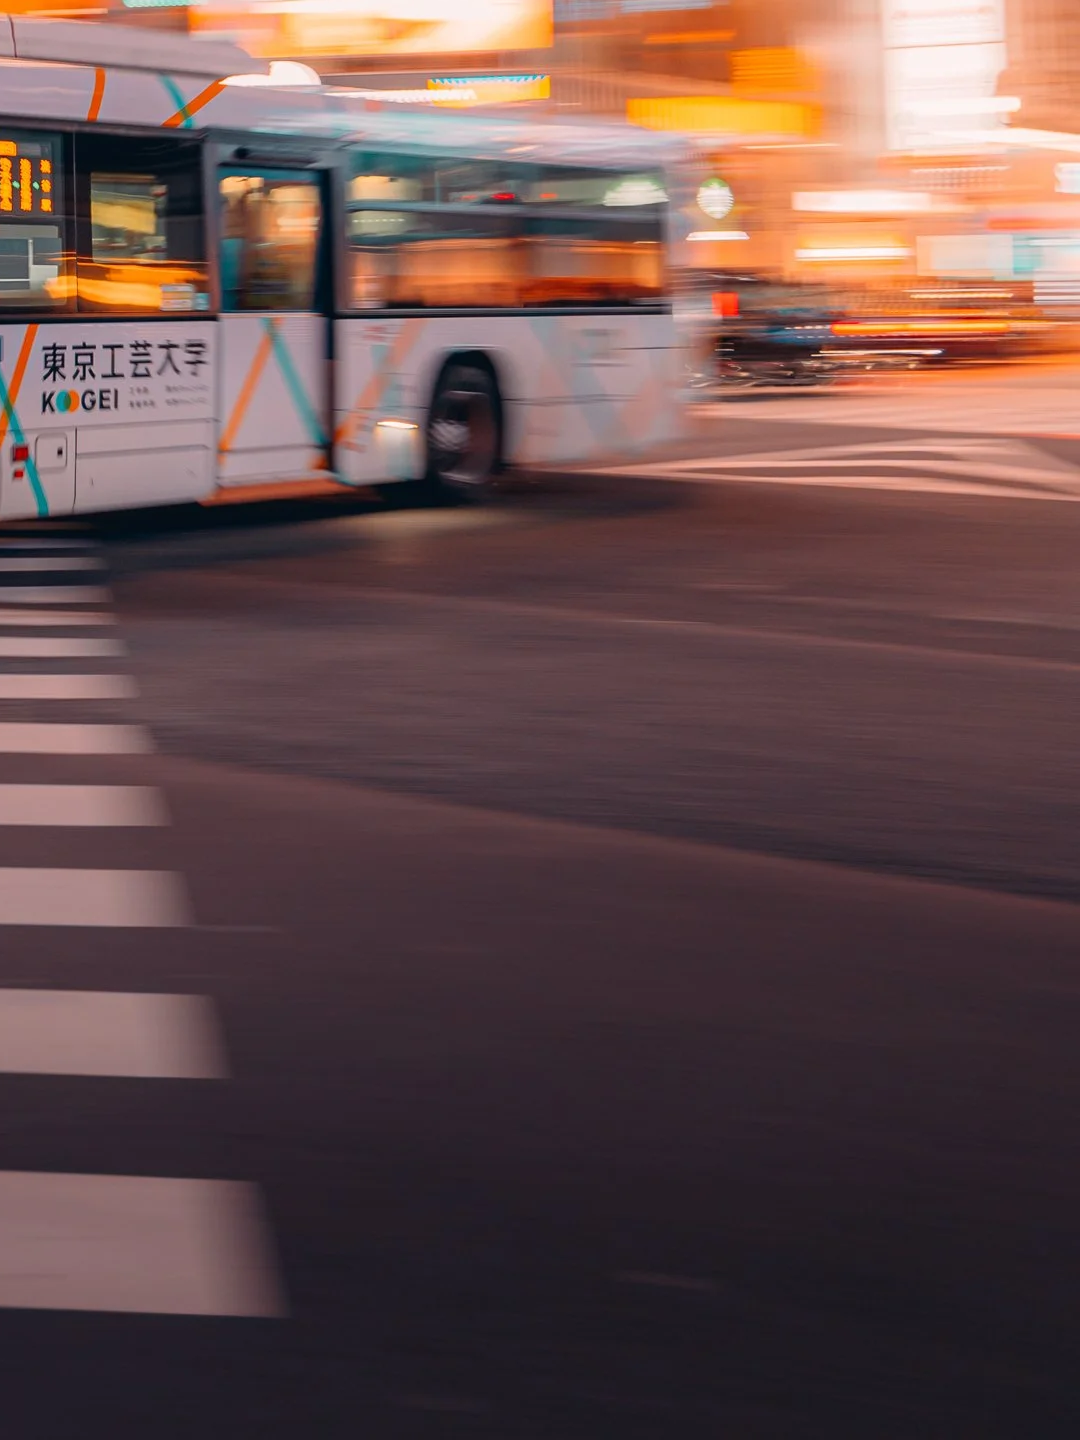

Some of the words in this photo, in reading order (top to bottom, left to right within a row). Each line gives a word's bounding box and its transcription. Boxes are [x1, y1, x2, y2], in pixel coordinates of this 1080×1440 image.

[41, 339, 208, 382] 東京工芸大学
[41, 388, 119, 414] KOGEI
